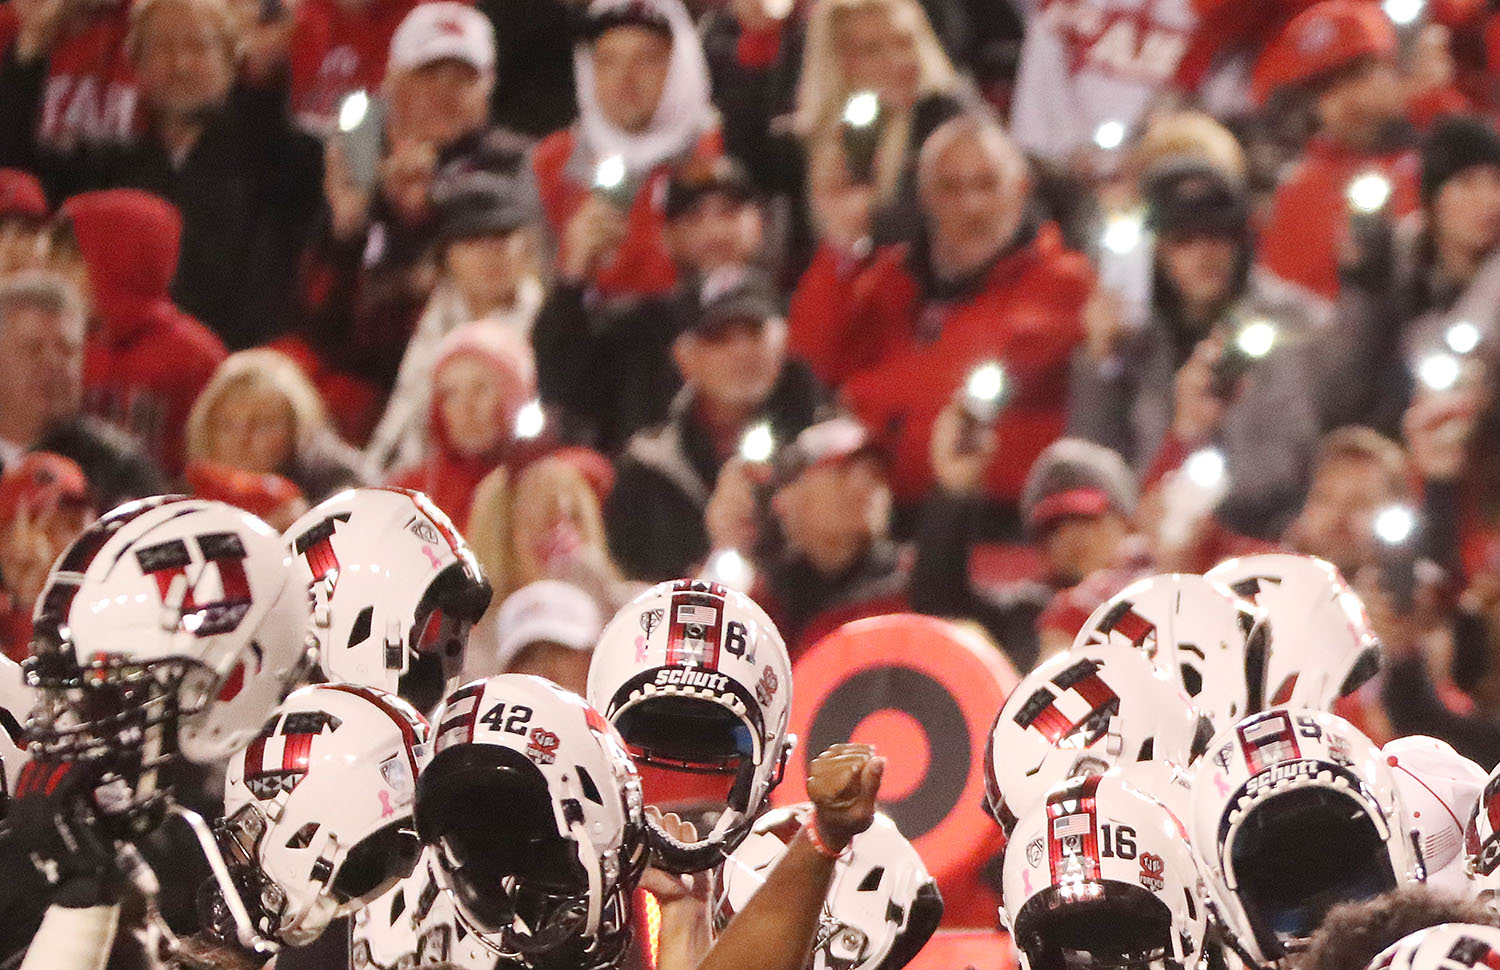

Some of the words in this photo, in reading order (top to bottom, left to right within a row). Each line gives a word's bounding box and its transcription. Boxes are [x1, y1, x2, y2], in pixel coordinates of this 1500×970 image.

[654, 667, 729, 691] schutt
[479, 703, 533, 737] 42
[1100, 824, 1137, 860] 16
